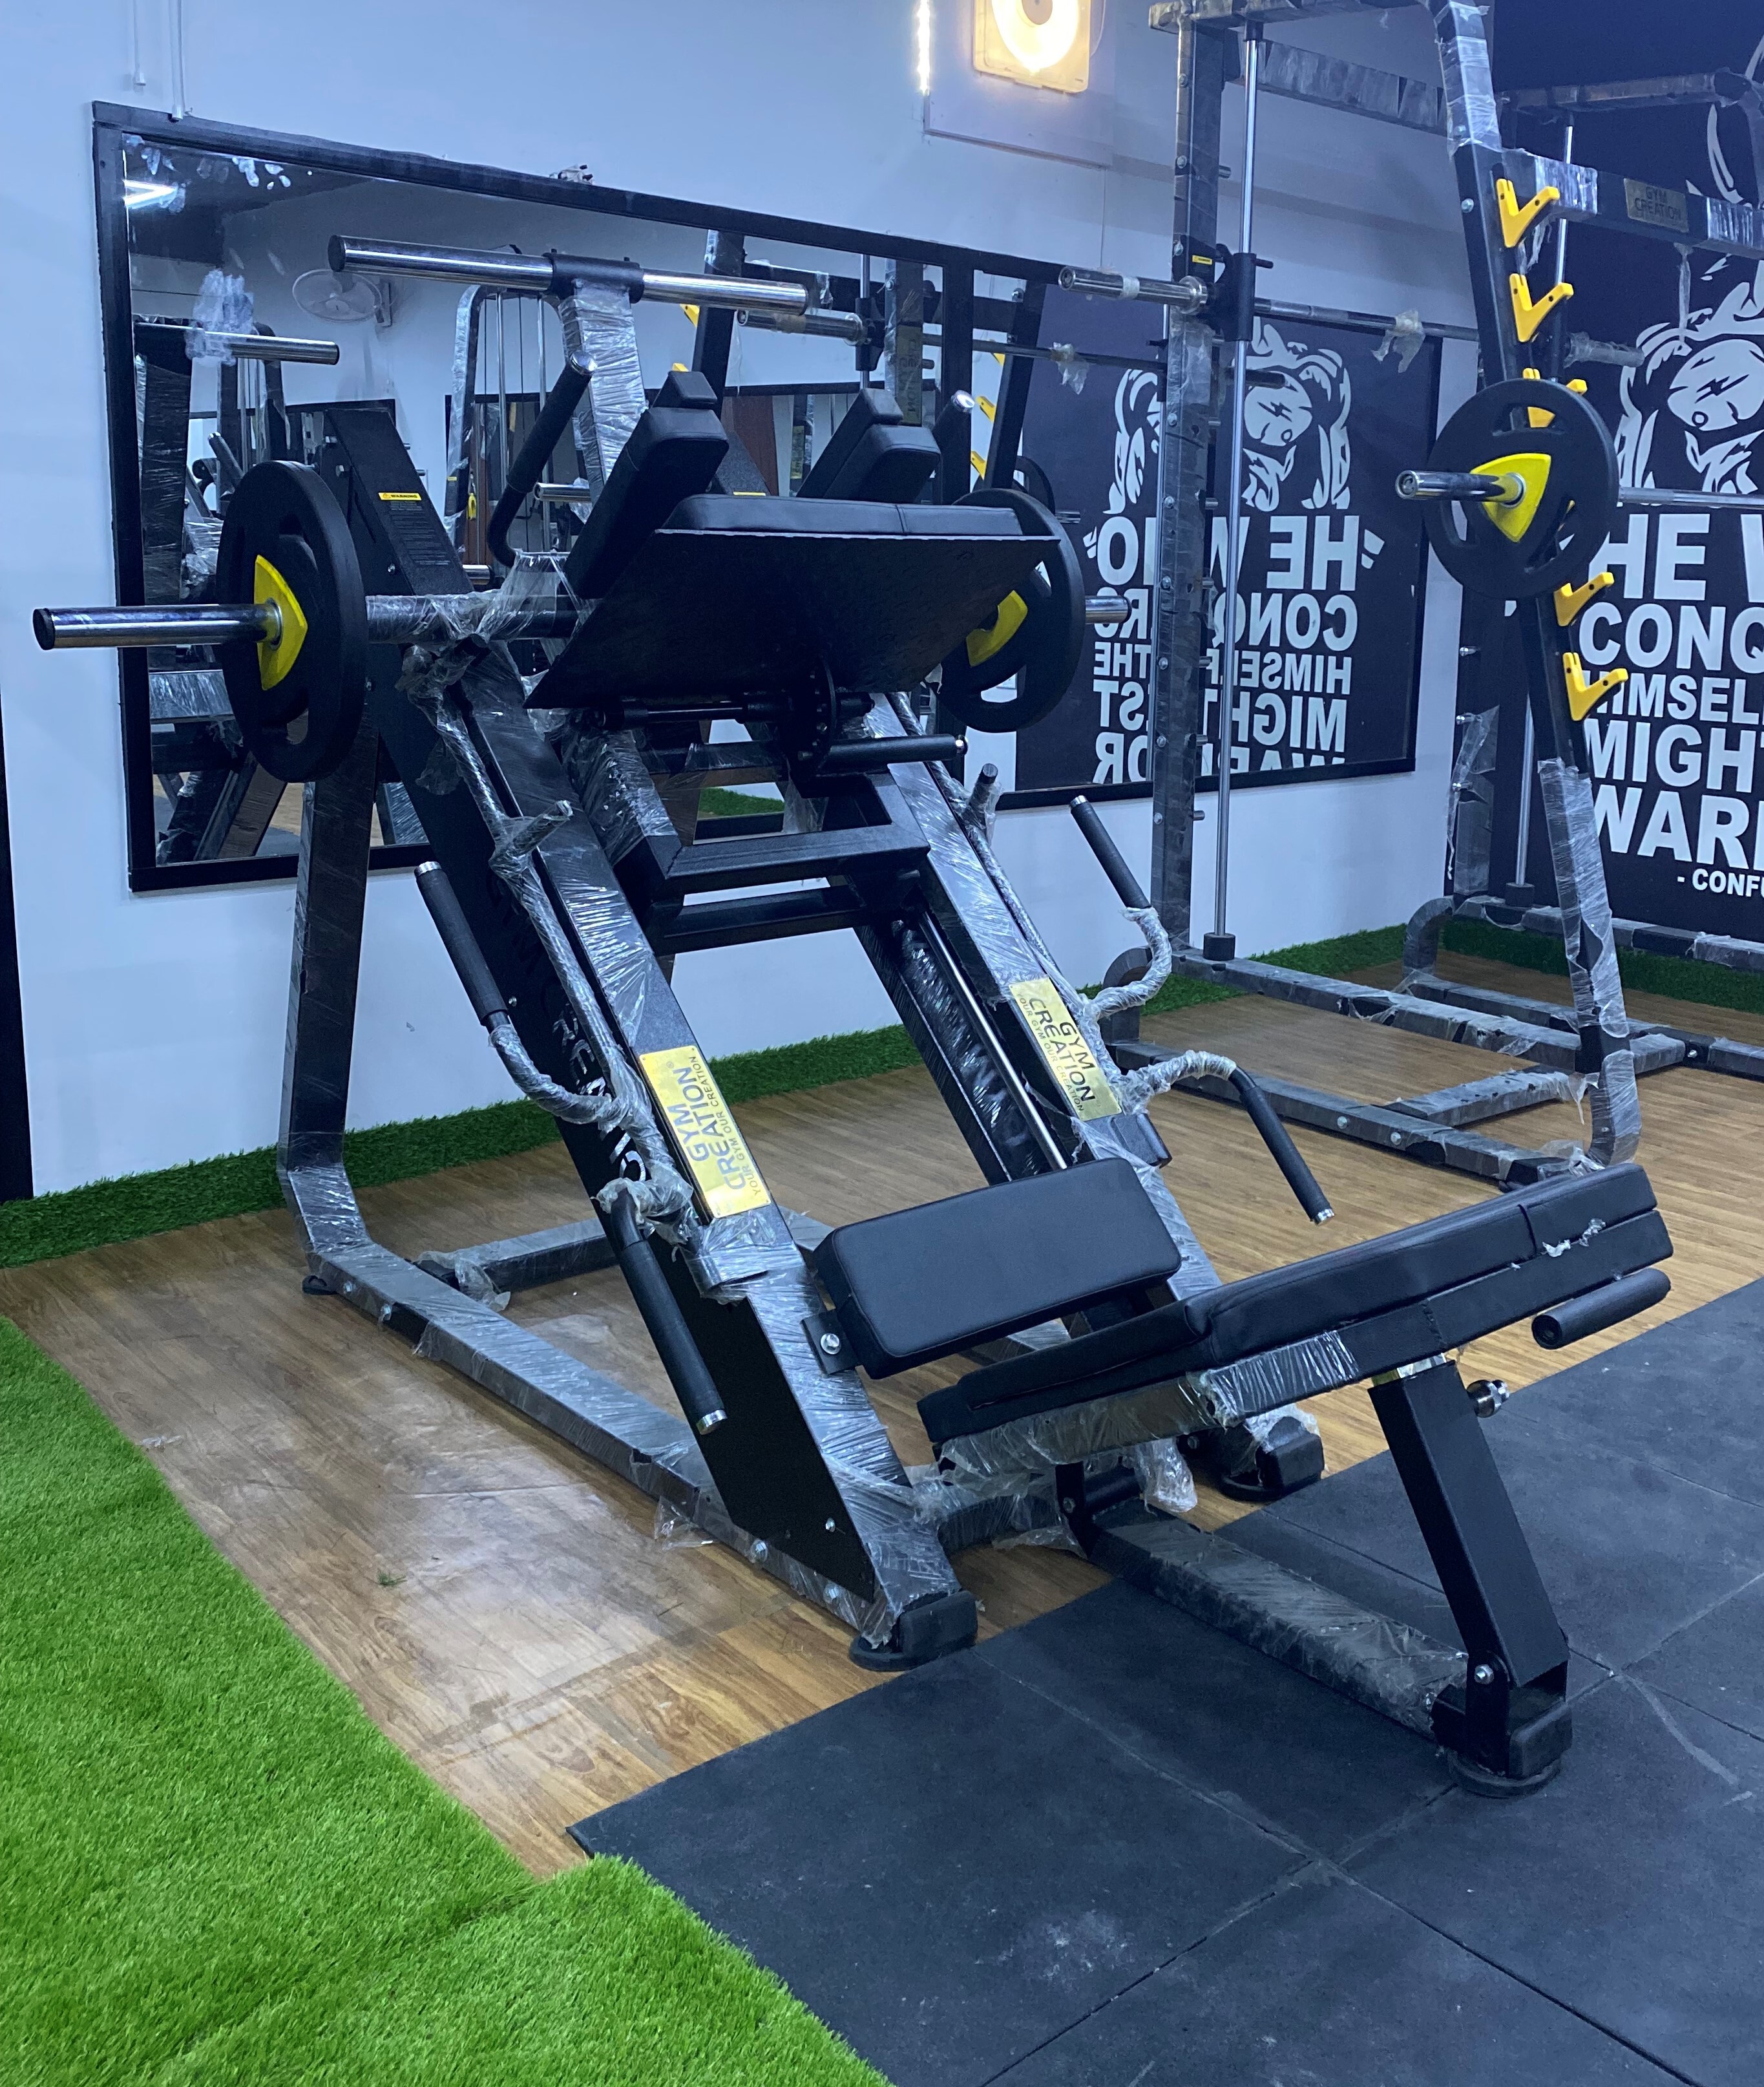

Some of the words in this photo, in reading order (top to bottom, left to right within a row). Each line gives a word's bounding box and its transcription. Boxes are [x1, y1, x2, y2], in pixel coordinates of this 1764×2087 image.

[1584, 718, 1764, 794] MIGH
[1594, 784, 1764, 871] WAR
[1692, 868, 1764, 898] CONF
[1029, 998, 1096, 1102] CREATION
[1031, 1020, 1045, 1040] GYM
[1044, 1043, 1058, 1063] OUR
[1056, 1066, 1084, 1111] CREATION
[1059, 1022, 1095, 1070] GYM
[688, 1055, 719, 1107] CREATION
[667, 1103, 710, 1161] GYM
[673, 1066, 746, 1190] CREATION
[717, 1110, 732, 1133] OUR
[729, 1138, 745, 1161] GYM
[739, 1164, 761, 1196] YOUR
